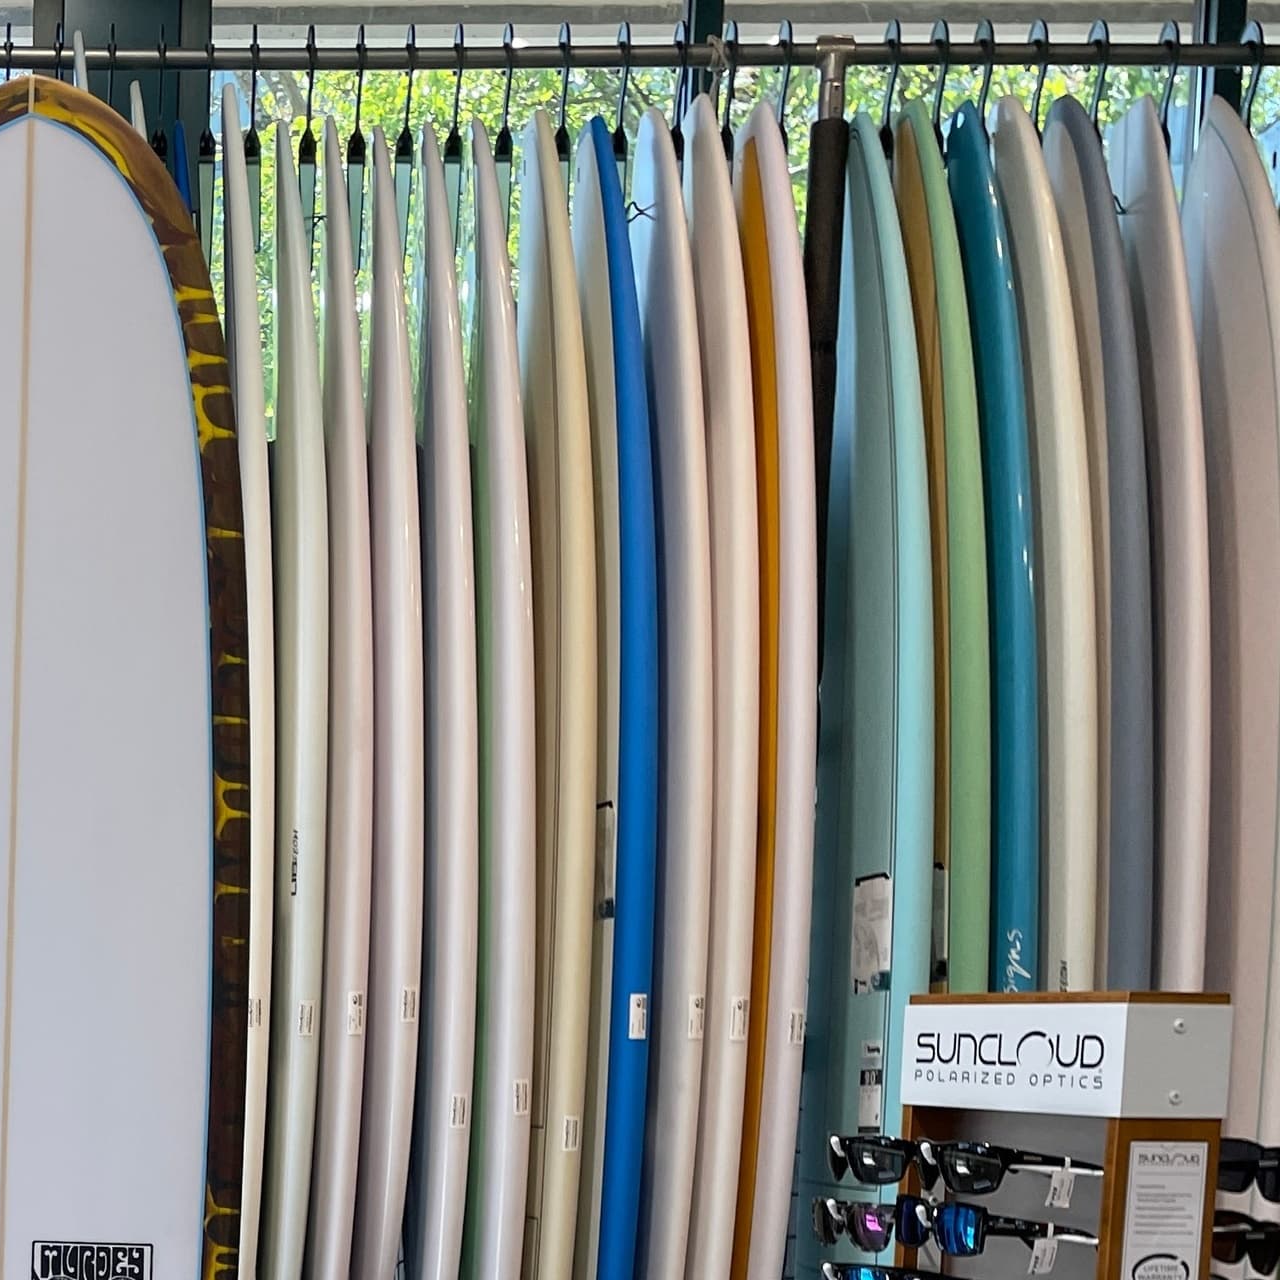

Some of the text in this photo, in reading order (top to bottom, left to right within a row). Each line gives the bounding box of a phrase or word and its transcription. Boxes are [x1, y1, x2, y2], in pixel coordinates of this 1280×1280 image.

[916, 1031, 1105, 1068] SUNCLOUD
[914, 1069, 1103, 1090] POLARIZED OPTICS
